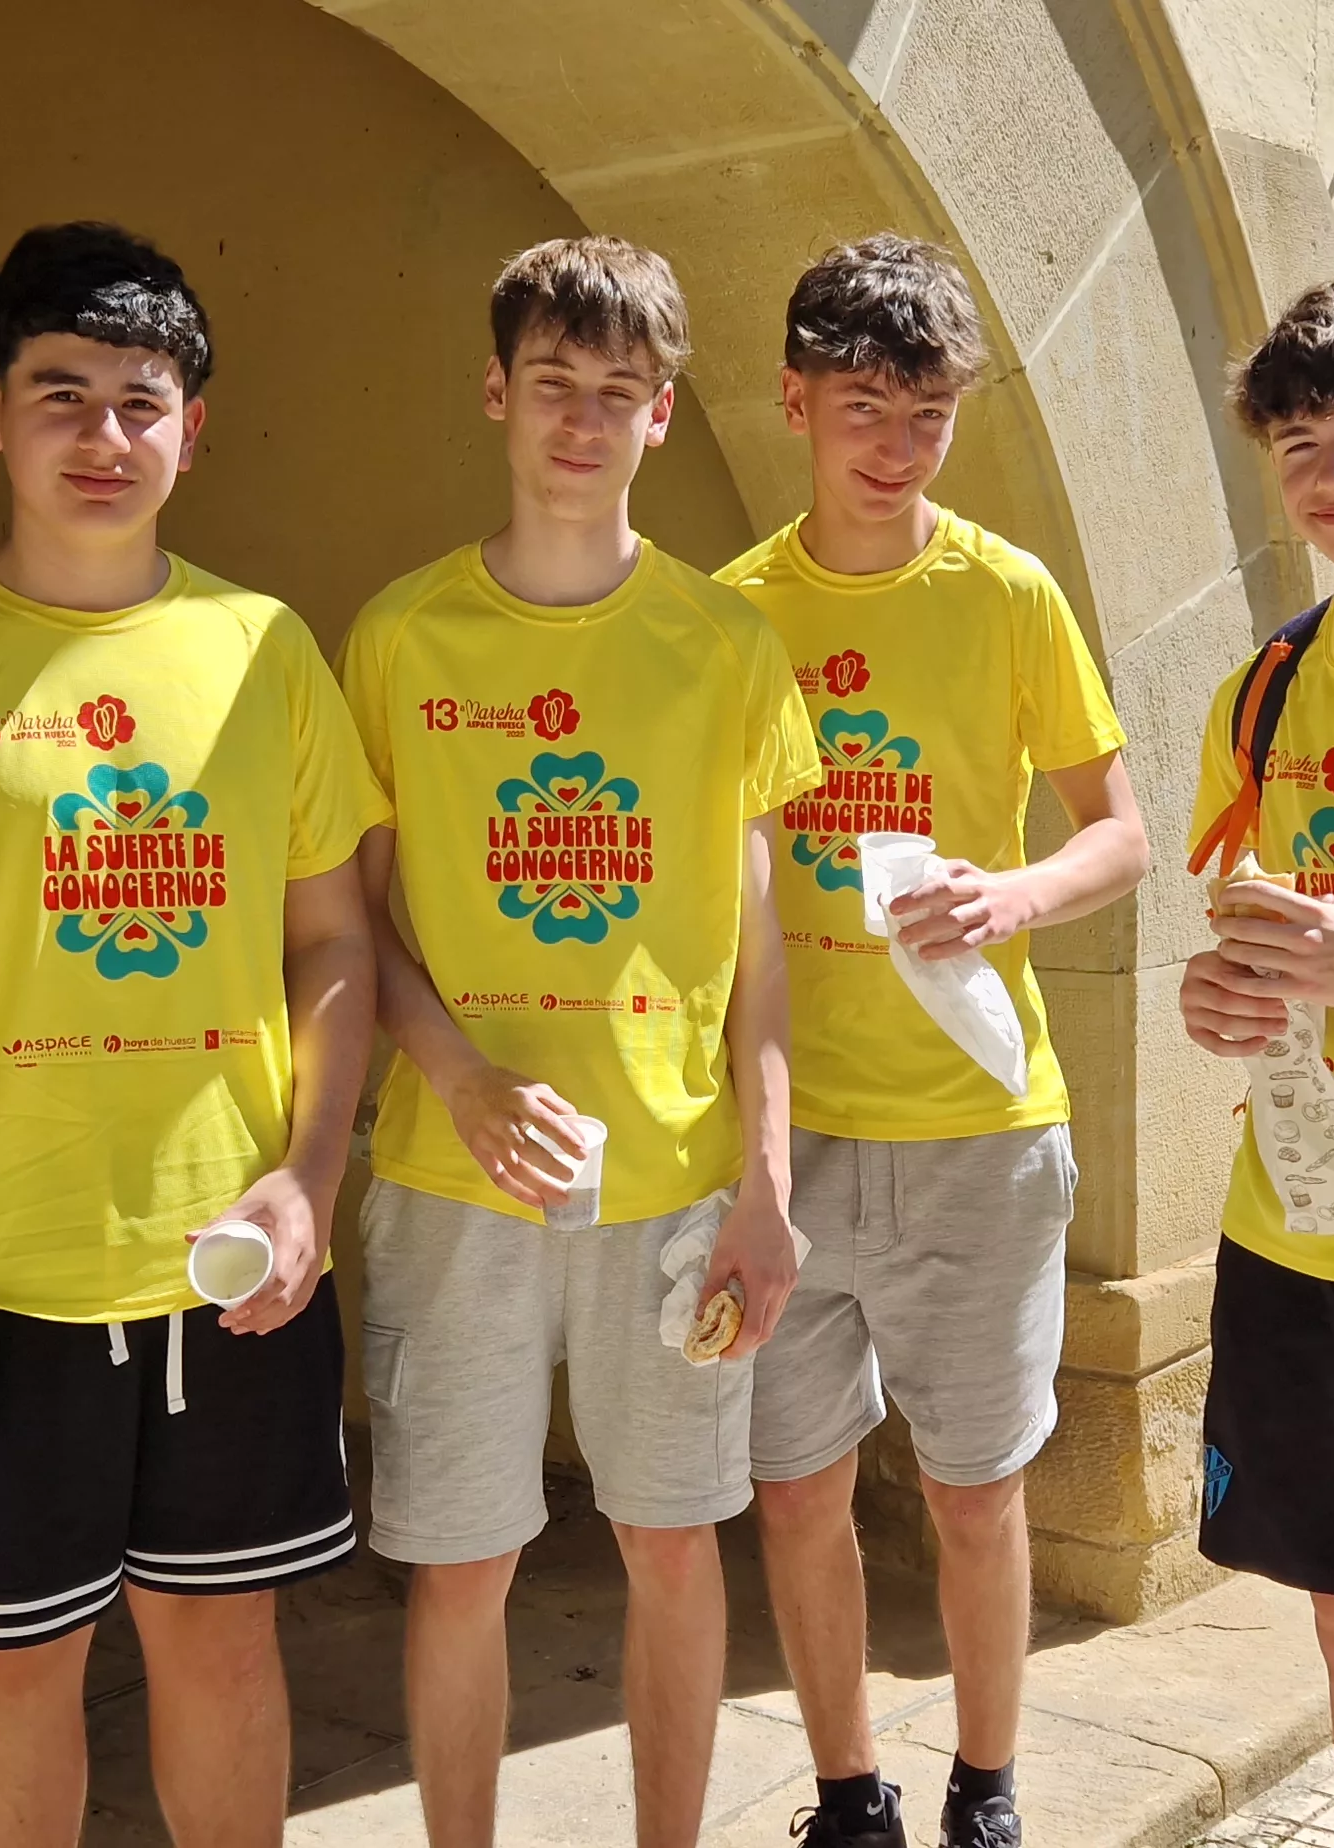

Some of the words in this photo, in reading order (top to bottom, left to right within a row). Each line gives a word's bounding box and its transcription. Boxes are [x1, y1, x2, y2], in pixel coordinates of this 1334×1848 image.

[466, 699, 525, 720] Marcha
[7, 710, 73, 731] Marcha
[466, 720, 493, 729] ASPACE
[496, 721, 525, 729] HUESCA
[11, 732, 41, 741] ASPACE
[45, 730, 76, 739] HUESCA
[905, 774, 932, 804] DE
[784, 801, 932, 836] CONOCERNOS
[488, 816, 520, 848] LA
[528, 815, 618, 848] SUERTE
[626, 817, 652, 849] DE
[44, 835, 79, 871] LA
[87, 833, 186, 870] SUERTE
[193, 833, 224, 869] DE
[486, 849, 653, 883] CONOCERNOS
[43, 871, 227, 911] CONOCERNOS
[471, 993, 529, 1006] ASPACE
[559, 998, 582, 1007] hoya
[583, 998, 594, 1006] de
[595, 998, 624, 1006] huesca
[24, 1036, 91, 1051] ASPACE
[123, 1038, 148, 1048] hoya
[151, 1038, 162, 1046] de
[164, 1037, 196, 1046] huesca
